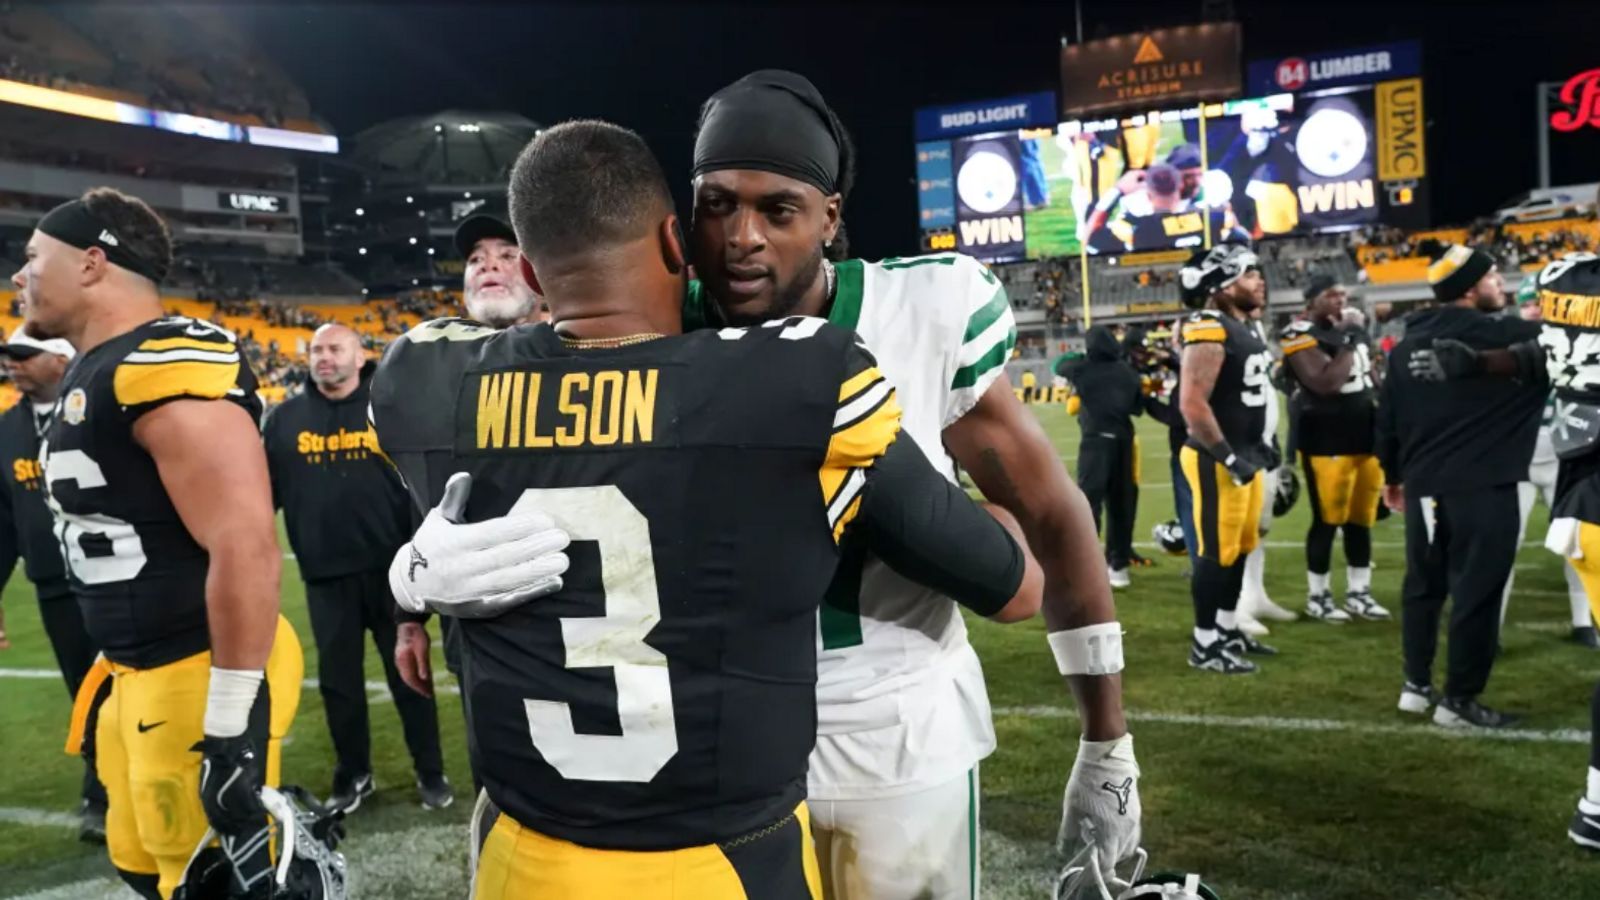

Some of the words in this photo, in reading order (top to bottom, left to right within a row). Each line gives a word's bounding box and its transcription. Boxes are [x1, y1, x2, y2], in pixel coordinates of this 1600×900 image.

[1098, 60, 1203, 88] ACRISURE
[1280, 64, 1304, 84] 84
[1310, 52, 1391, 80] LUMBER
[1117, 81, 1182, 99] STADIUM
[940, 111, 976, 128] BUD
[977, 104, 1027, 124] LIGHT
[1391, 84, 1418, 173] UPMC
[229, 193, 279, 212] UPMC
[1298, 179, 1375, 214] WIN
[960, 215, 1024, 246] WIN
[476, 369, 659, 449] WILSON
[505, 484, 679, 783] 3
